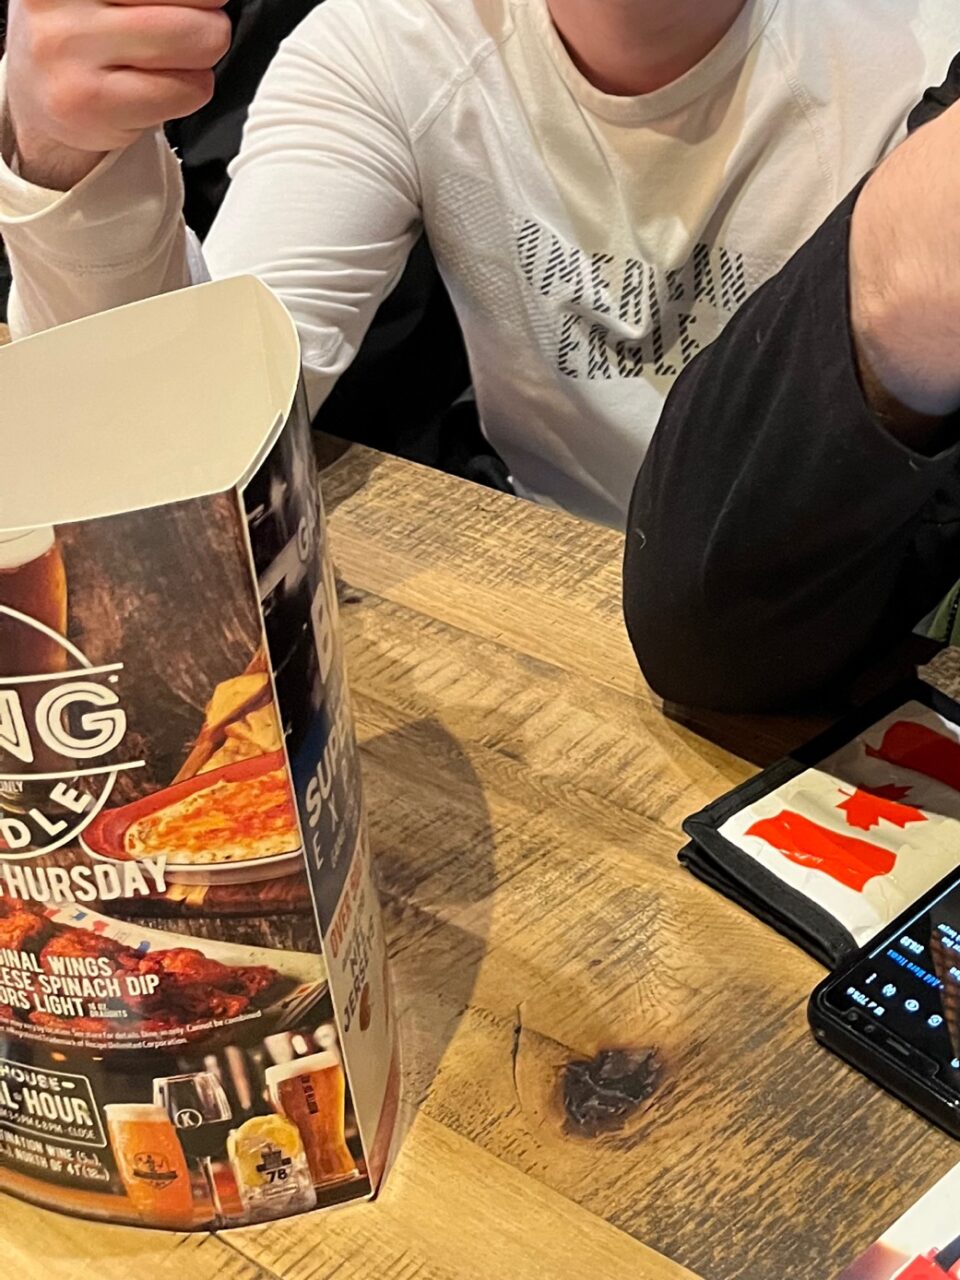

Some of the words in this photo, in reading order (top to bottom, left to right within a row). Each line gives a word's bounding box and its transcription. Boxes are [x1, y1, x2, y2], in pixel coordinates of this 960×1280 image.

[0, 856, 167, 903] HURSDAY
[0, 966, 35, 990] ESE
[39, 973, 121, 999] SPINACH
[127, 972, 160, 997] DIP
[49, 954, 111, 979] WINGS
[33, 993, 85, 1019] LIGHT
[22, 1086, 93, 1126] HOUR
